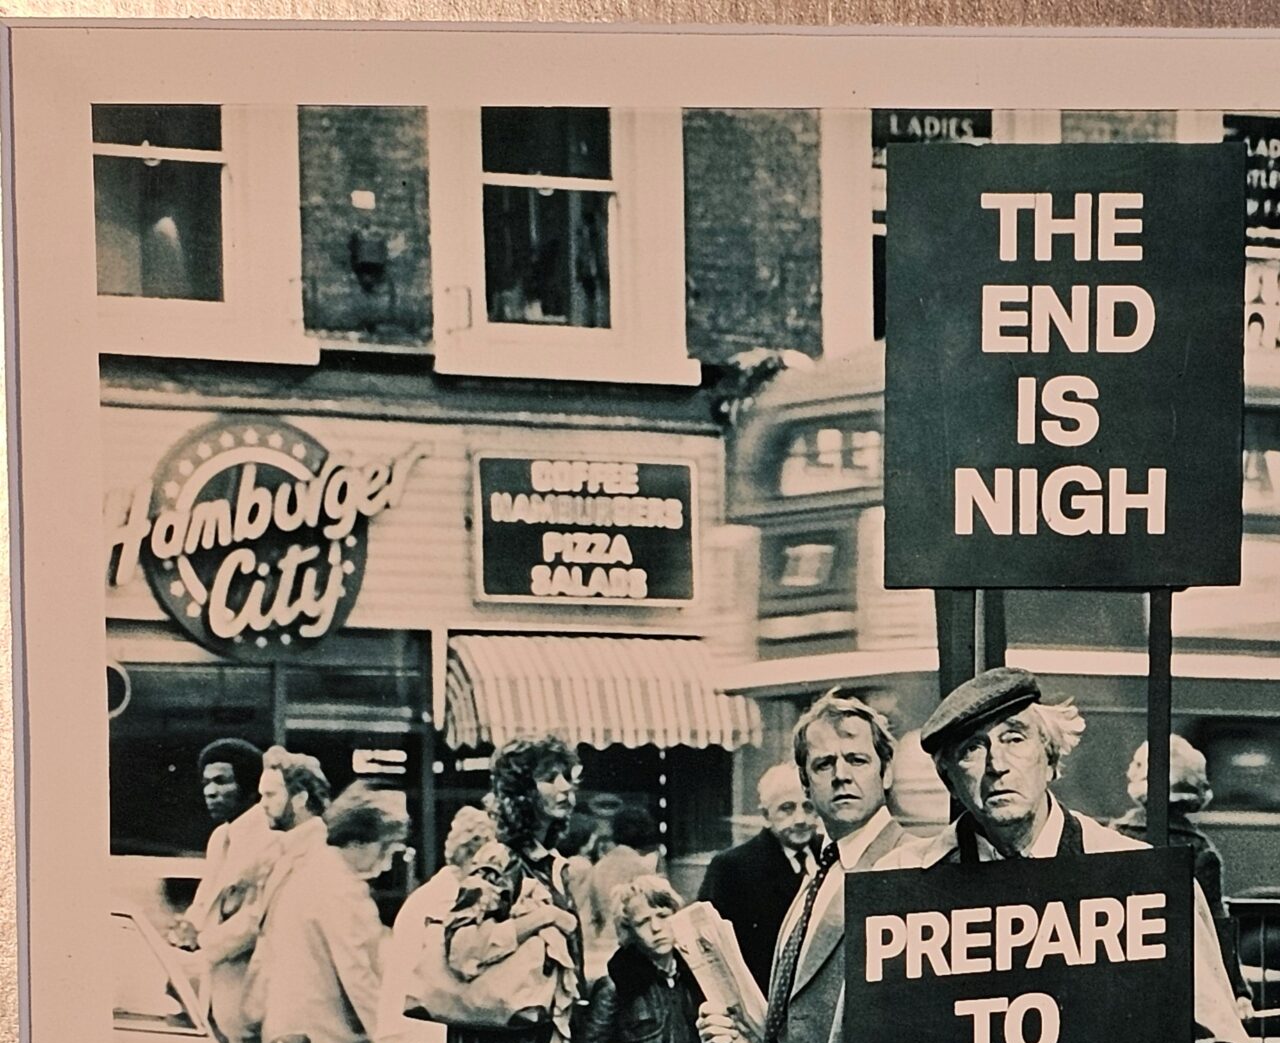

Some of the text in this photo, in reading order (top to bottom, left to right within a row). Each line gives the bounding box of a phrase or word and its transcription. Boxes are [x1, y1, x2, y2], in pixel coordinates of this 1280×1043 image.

[889, 113, 975, 140] LADIES
[981, 192, 1144, 261] THE
[981, 285, 1156, 353] END
[1017, 375, 1100, 447] IS
[491, 492, 684, 530] HAMBURGERS
[531, 460, 640, 494] COFFEE
[954, 465, 1167, 536] NIGH
[103, 441, 433, 588] Hamburger
[542, 532, 633, 565] PIZZA
[209, 541, 347, 638] City
[531, 565, 648, 598] SALADS
[865, 893, 1167, 983] PREPARE
